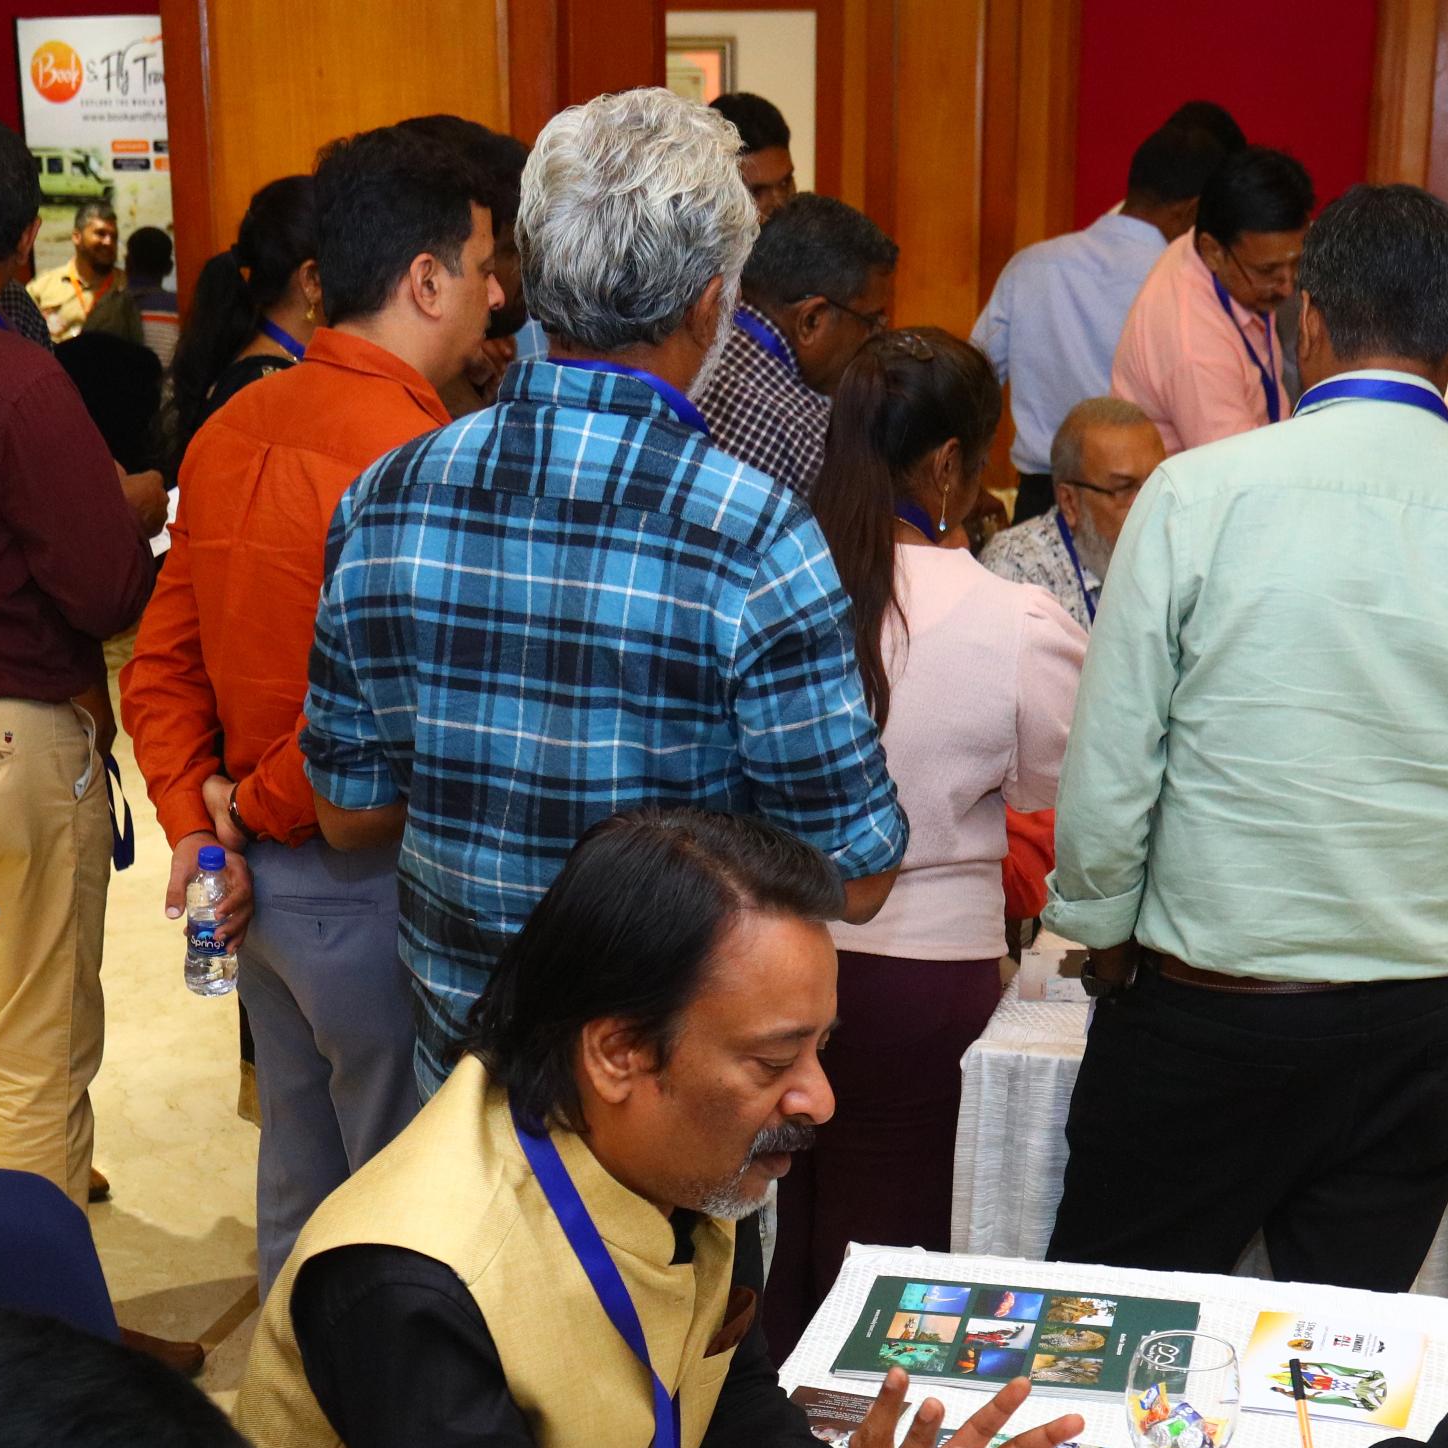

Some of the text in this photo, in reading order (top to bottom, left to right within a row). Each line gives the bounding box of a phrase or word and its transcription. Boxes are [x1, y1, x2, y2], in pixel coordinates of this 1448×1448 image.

[33, 51, 81, 90] Book
[101, 50, 131, 95] Fly
[190, 934, 226, 951] Springs
